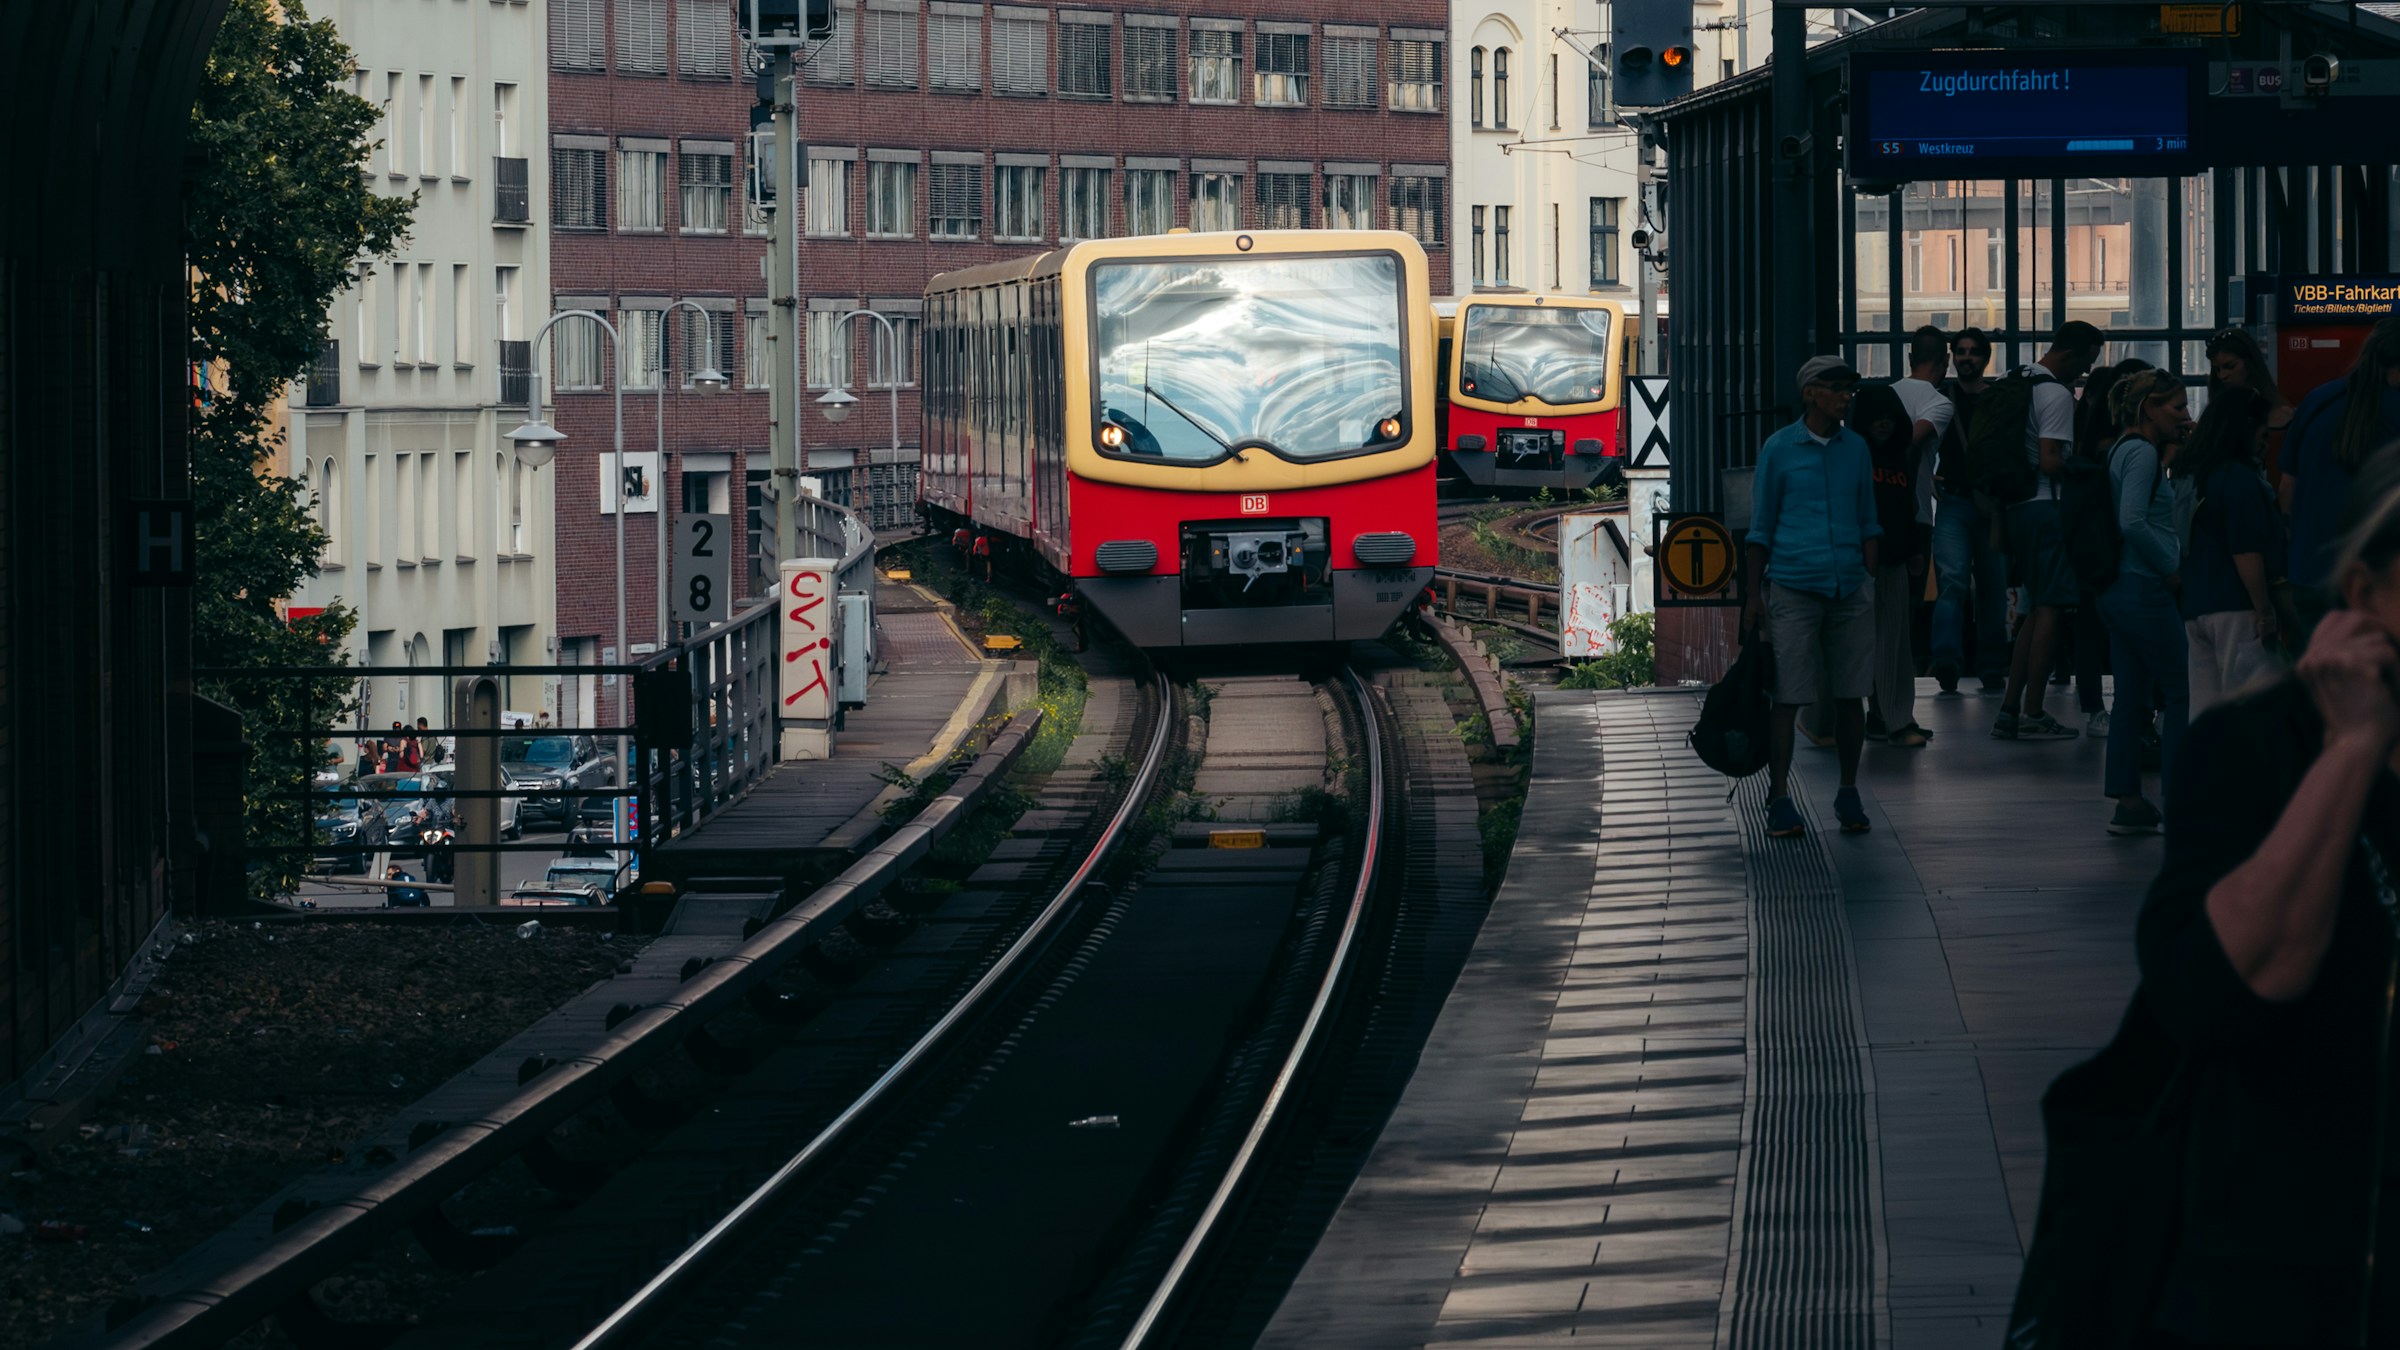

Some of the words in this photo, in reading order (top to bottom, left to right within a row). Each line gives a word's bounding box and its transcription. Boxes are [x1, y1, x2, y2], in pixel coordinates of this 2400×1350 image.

[2258, 75, 2282, 86] BUS
[1918, 142, 1975, 155] Westkreuz
[2156, 138, 2164, 151] 3
[2166, 137, 2187, 150] min
[2293, 284, 2400, 301] VBB-Fahrkart
[2293, 303, 2393, 315] Tickets/Billets/Biglietti
[2291, 339, 2307, 349] DB
[1245, 497, 1265, 510] DB
[138, 511, 183, 572] H
[692, 519, 713, 557] 2
[689, 574, 711, 612] 8
